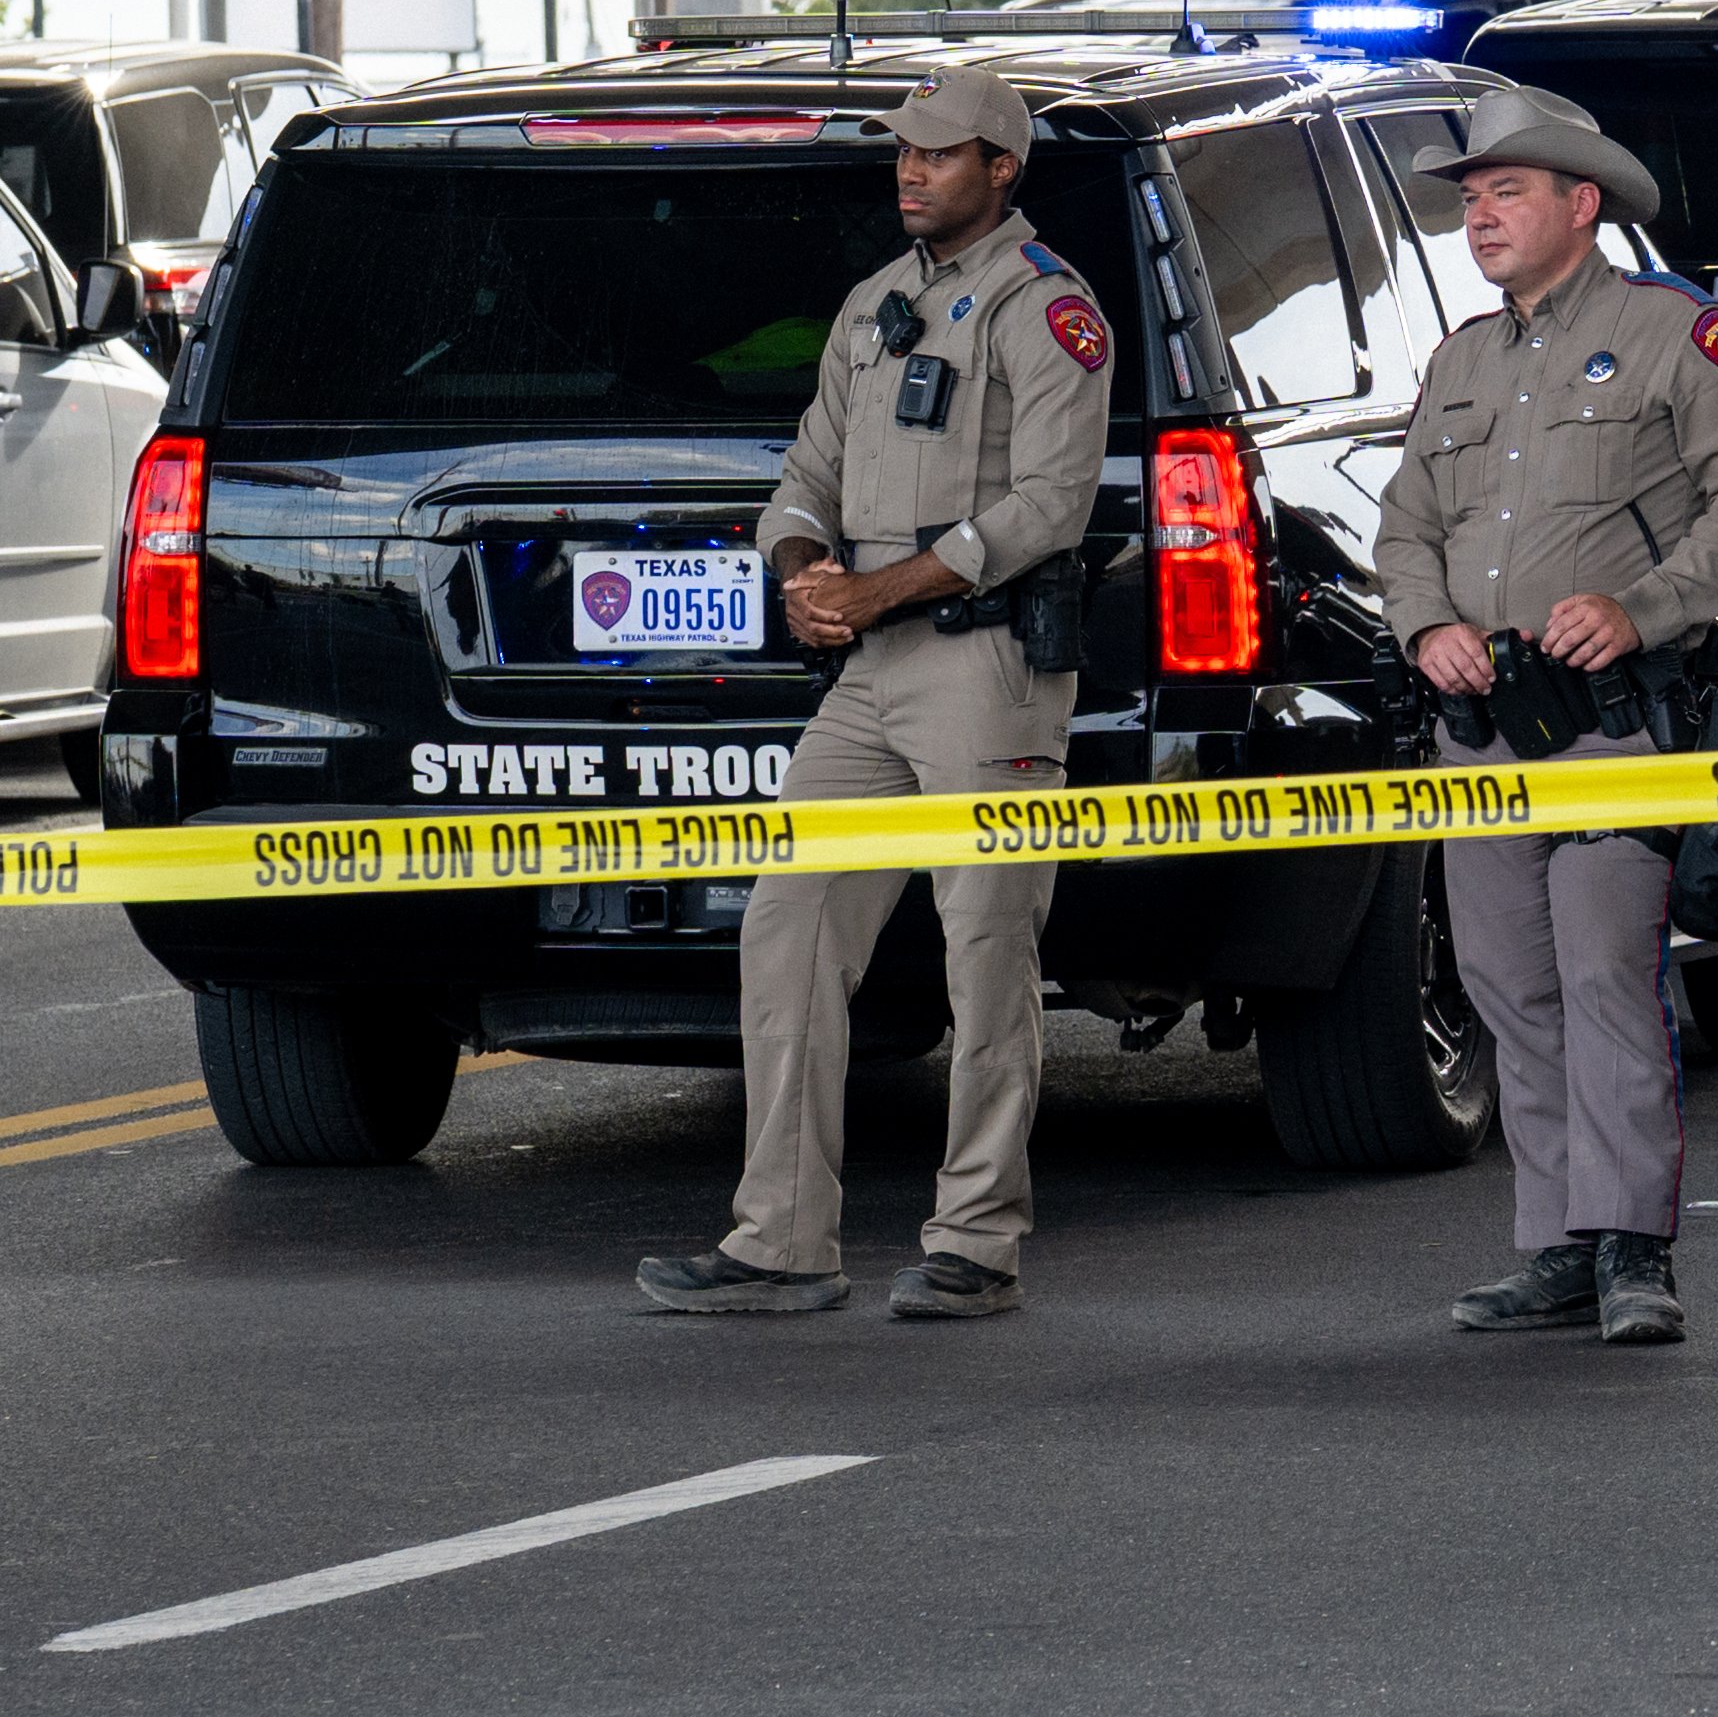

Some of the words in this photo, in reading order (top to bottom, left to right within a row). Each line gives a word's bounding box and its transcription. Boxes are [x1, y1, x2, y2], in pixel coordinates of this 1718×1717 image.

[635, 559, 707, 577] TEXAS
[641, 588, 747, 631] 09550
[621, 634, 647, 642] TEXAS
[648, 634, 685, 642] HIGHWAY
[687, 634, 717, 642] PATROL
[410, 742, 606, 796] STATE
[626, 744, 798, 797] TROO
[972, 795, 1107, 854] CROSS
[1122, 791, 1201, 846] NOT
[1217, 788, 1271, 841] DO
[1285, 783, 1375, 836] LINE
[1388, 773, 1530, 831] POLICE
[254, 828, 382, 887] CROSS
[398, 825, 473, 881] NOT
[490, 822, 541, 877] DO
[556, 818, 643, 874] LINE
[656, 811, 795, 867] POLICE
